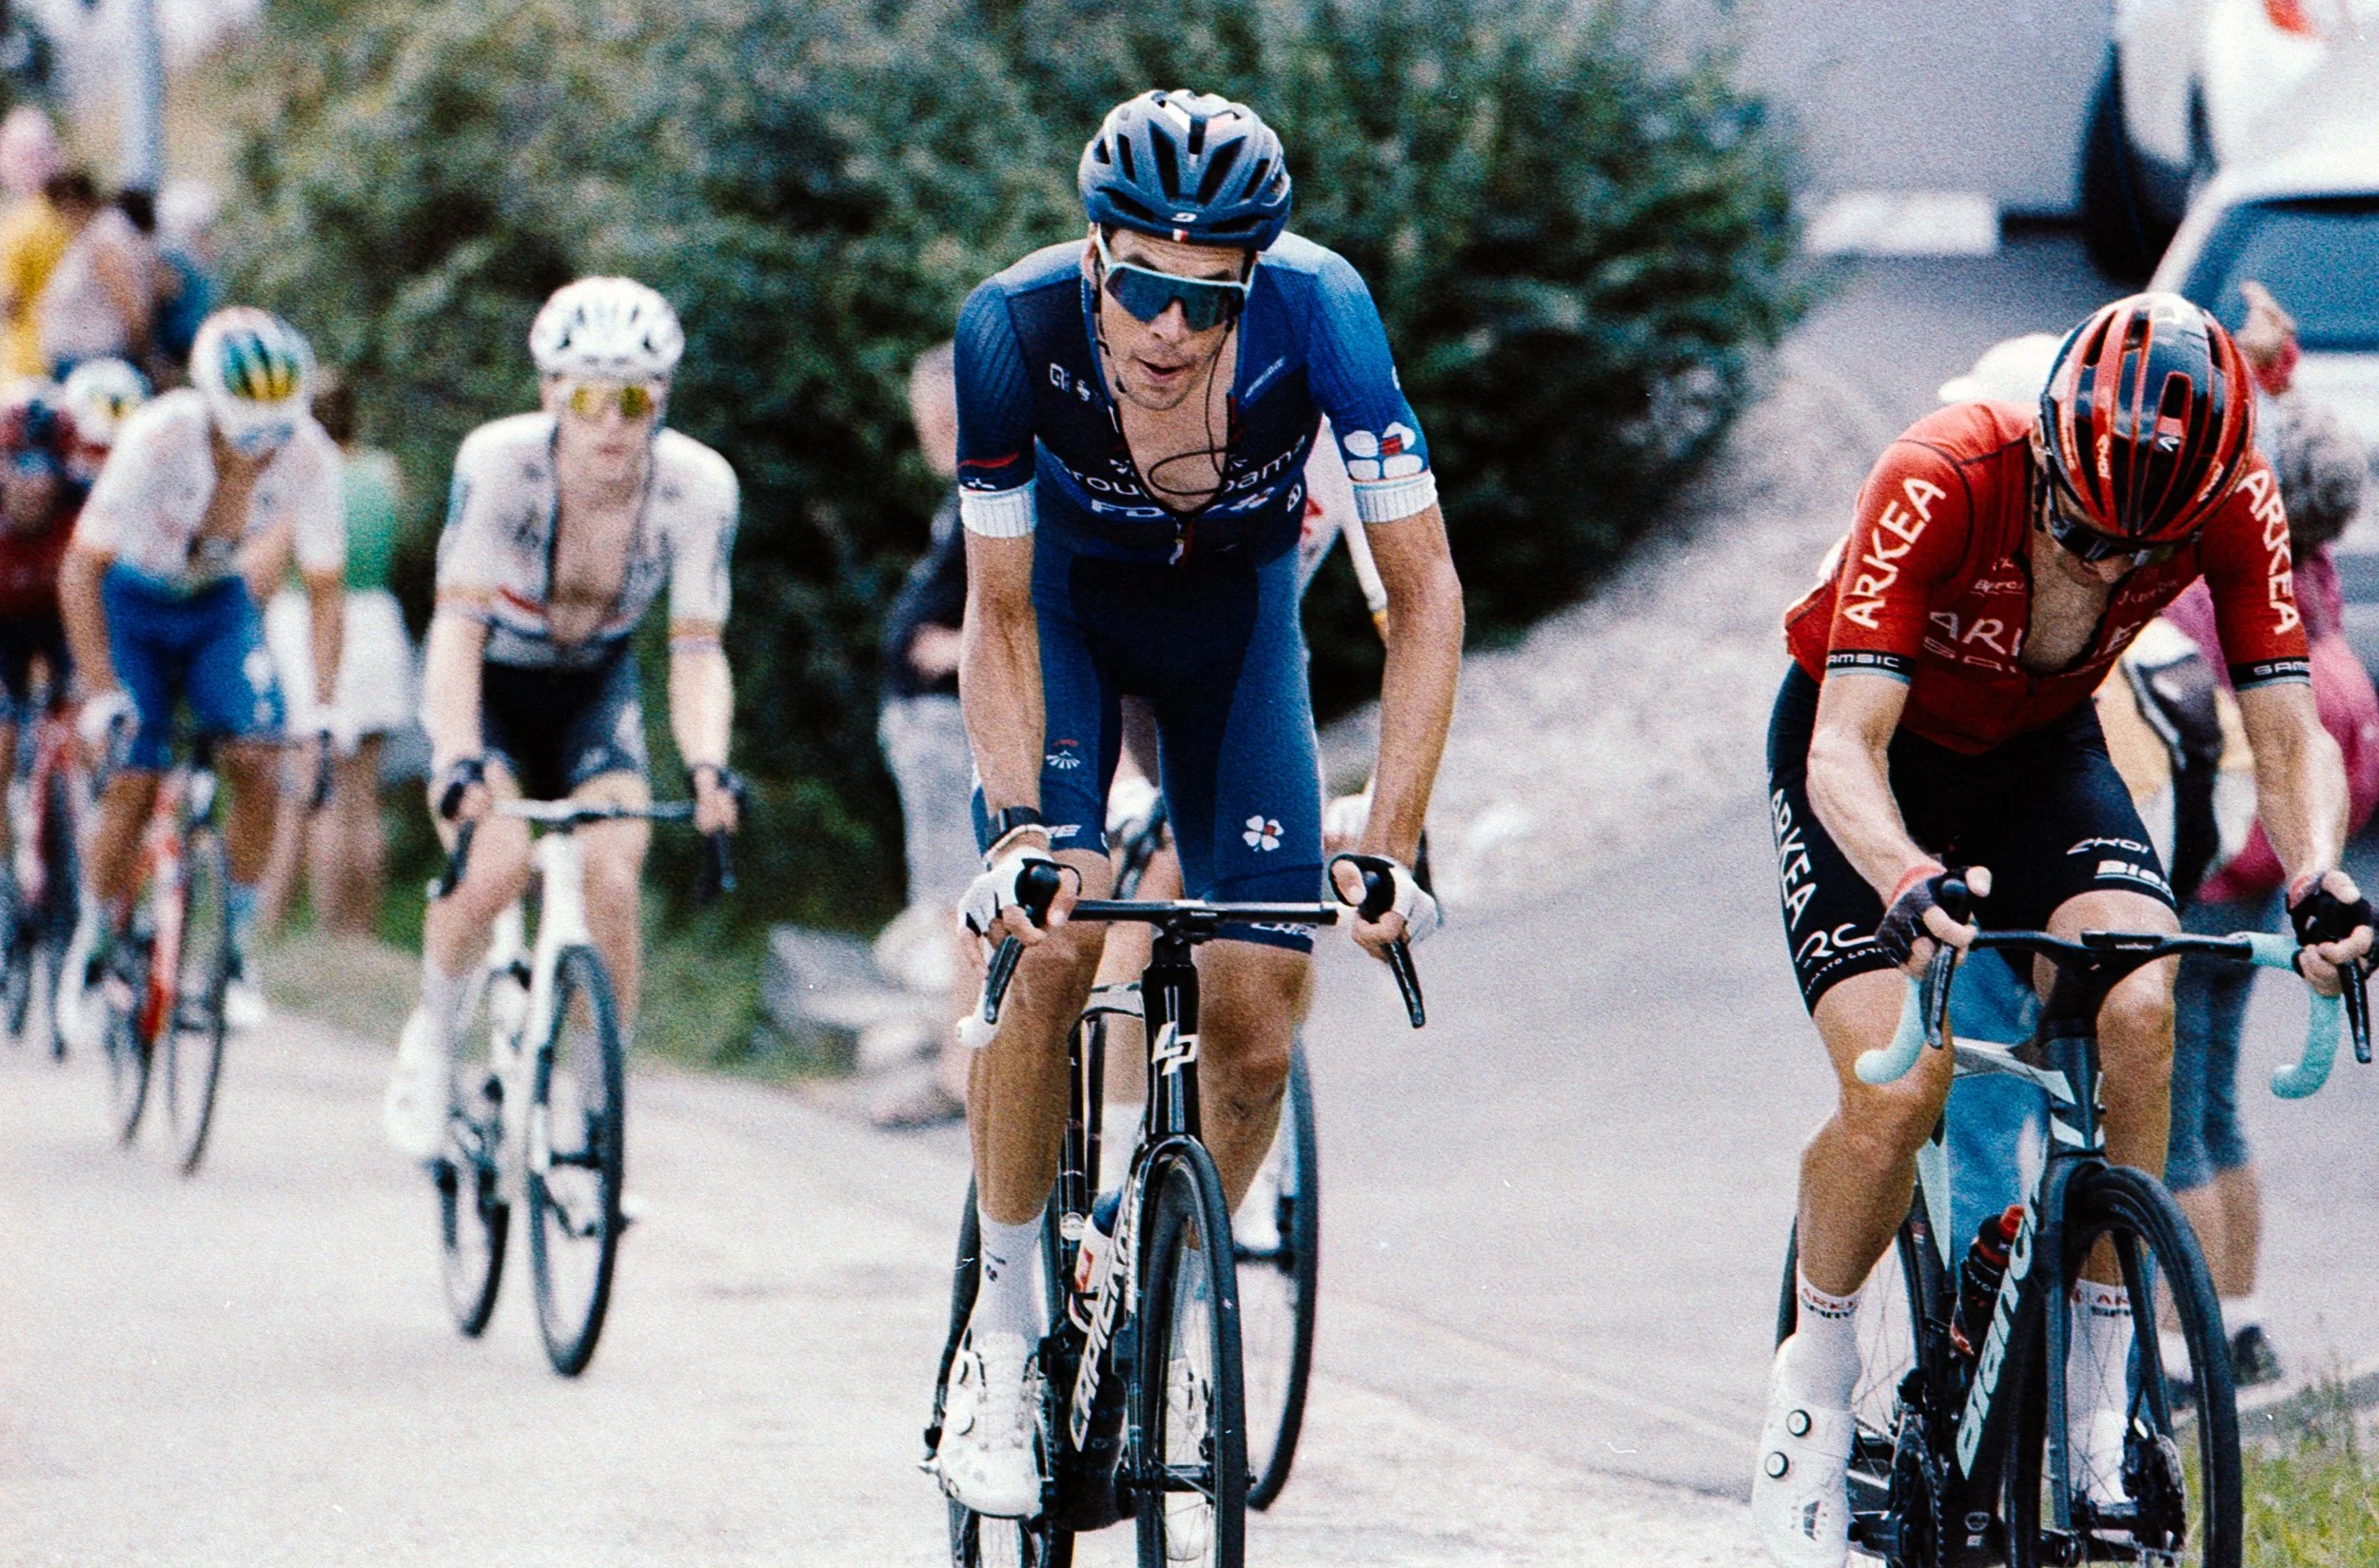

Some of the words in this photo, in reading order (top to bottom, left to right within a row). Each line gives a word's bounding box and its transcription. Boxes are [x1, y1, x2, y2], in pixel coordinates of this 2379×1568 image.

[1843, 478, 1947, 630] ARKEA
[2236, 469, 2300, 636] ARKEA
[1827, 653, 1899, 668] AMSIC
[2253, 659, 2310, 676] SAM
